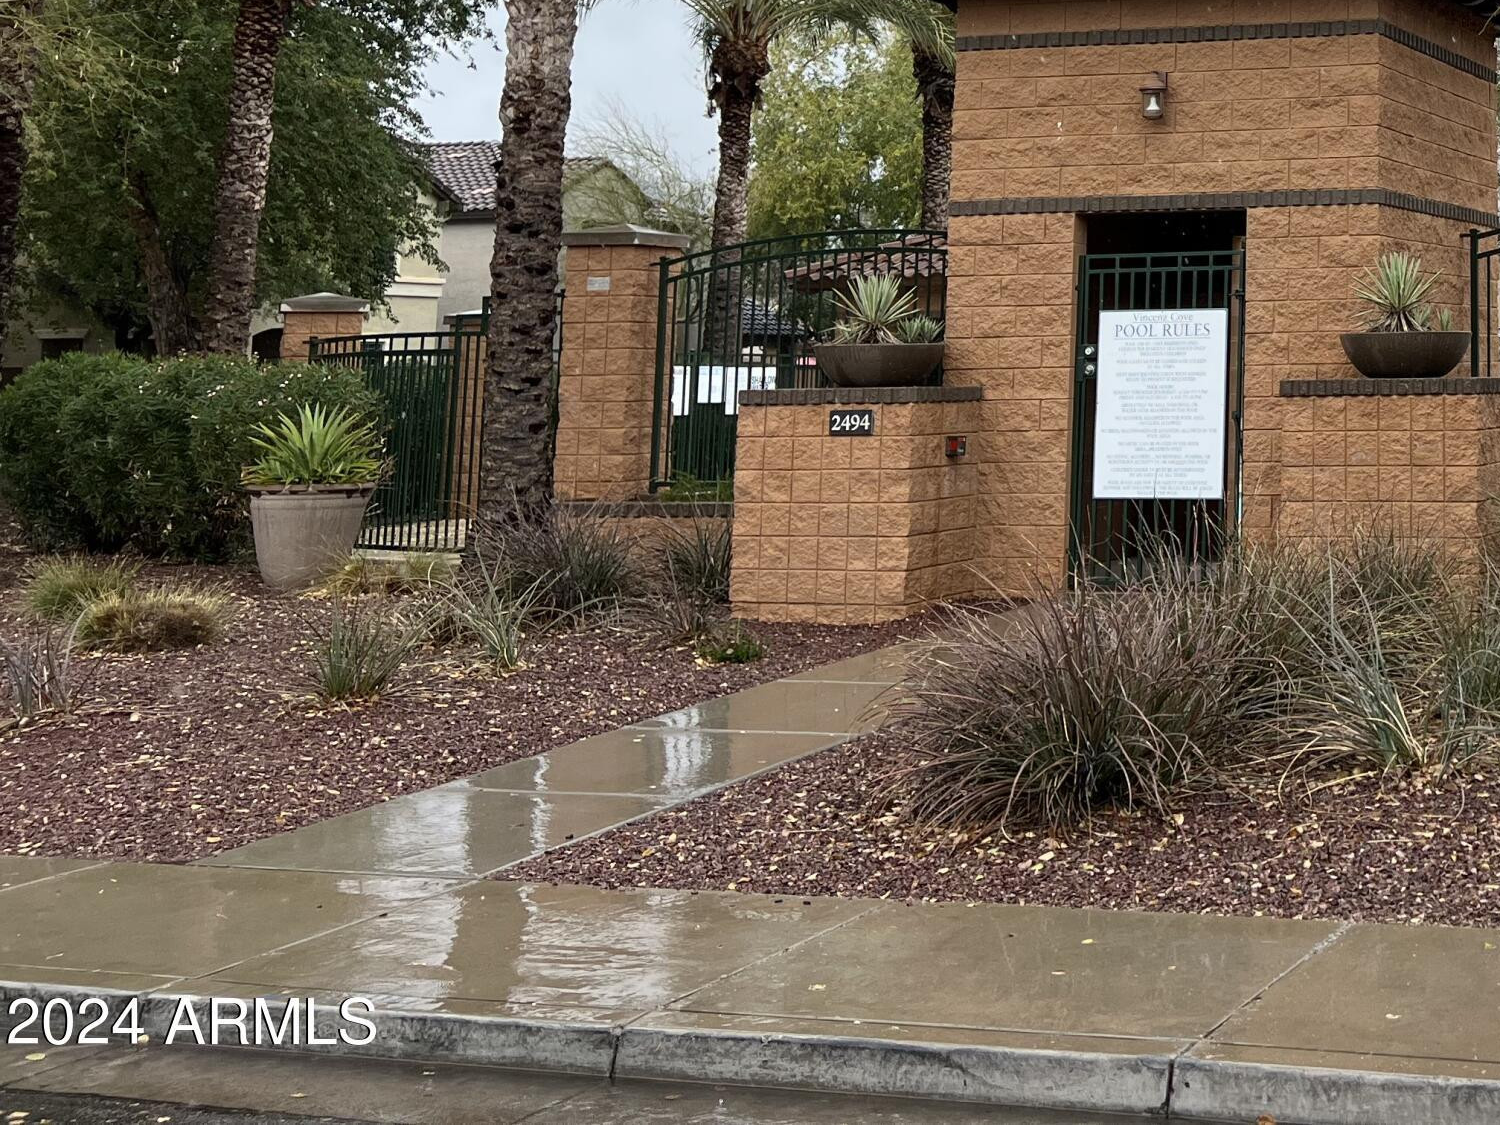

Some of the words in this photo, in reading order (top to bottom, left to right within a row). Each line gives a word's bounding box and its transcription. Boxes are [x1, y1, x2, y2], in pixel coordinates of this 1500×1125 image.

[1170, 313, 1193, 321] Cove
[1114, 324, 1158, 337] POOL
[1163, 323, 1211, 337] RULES
[831, 414, 870, 431] 2494
